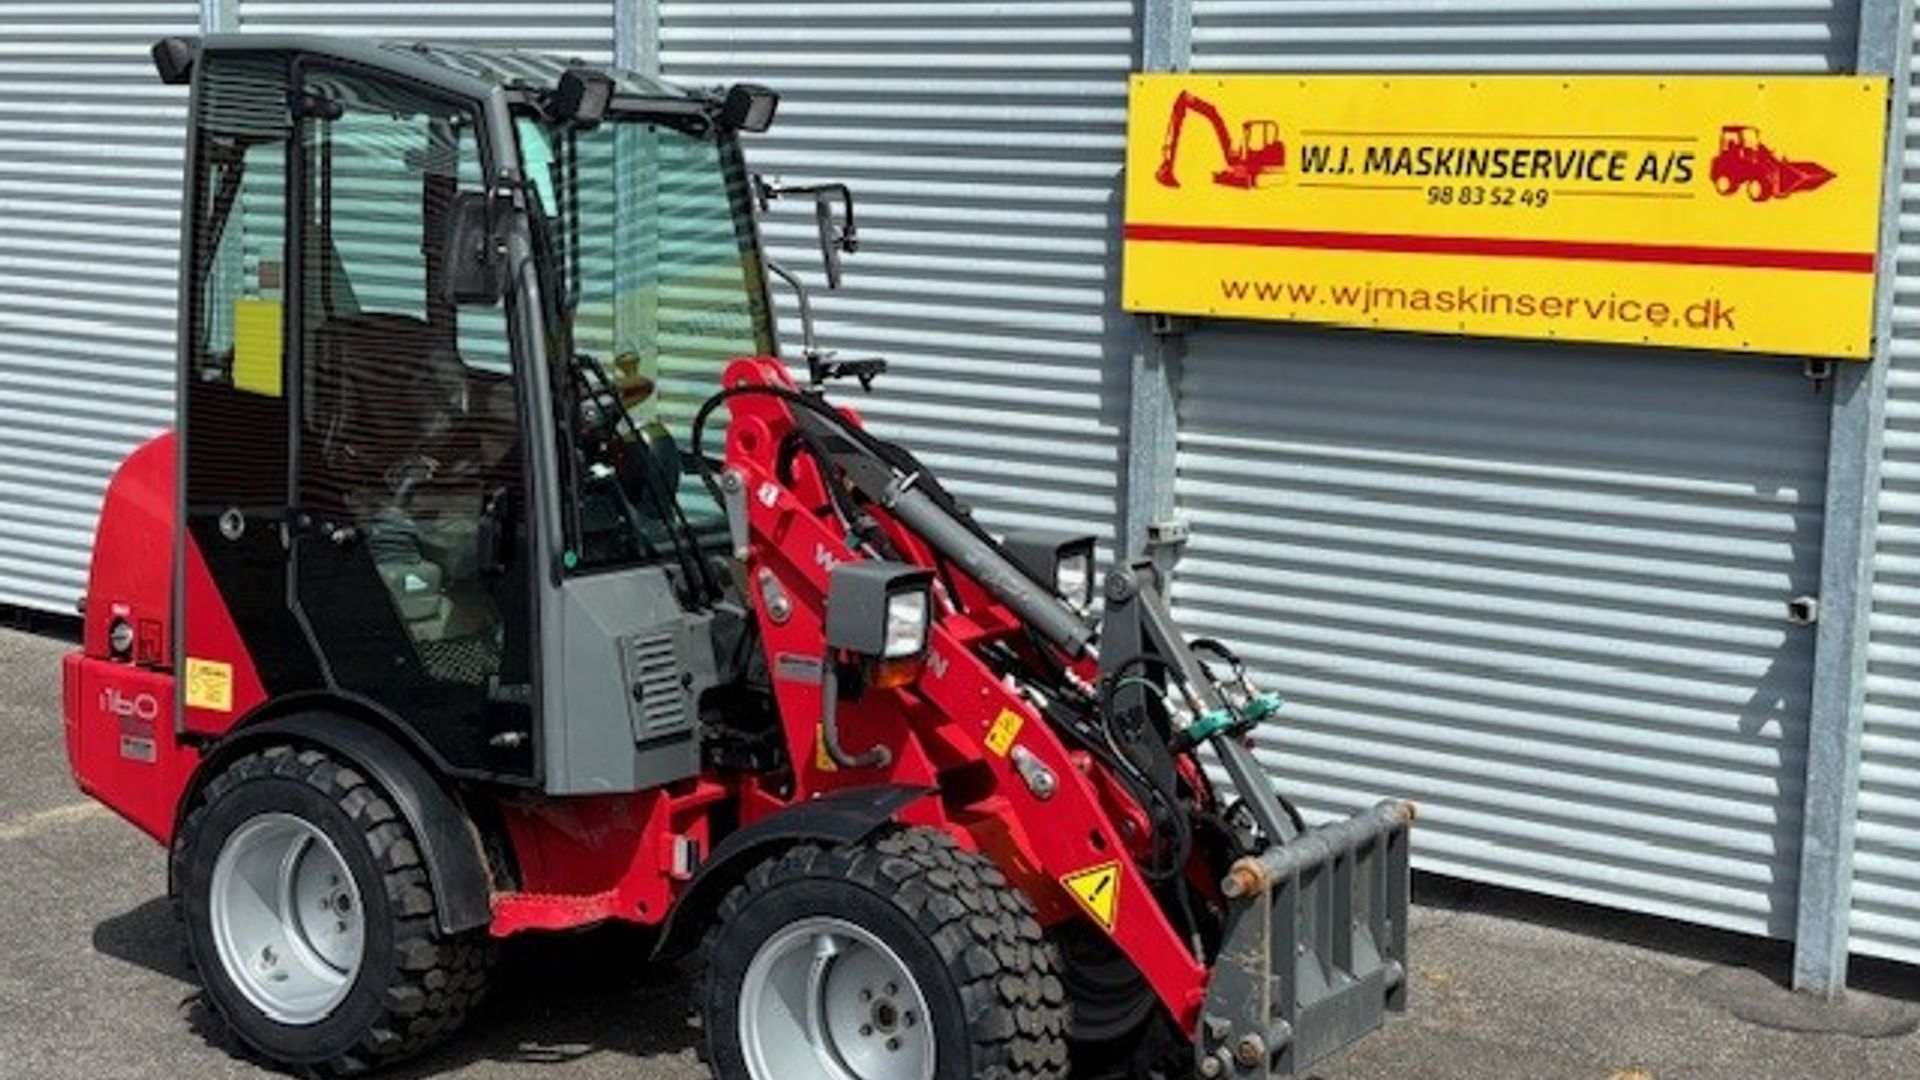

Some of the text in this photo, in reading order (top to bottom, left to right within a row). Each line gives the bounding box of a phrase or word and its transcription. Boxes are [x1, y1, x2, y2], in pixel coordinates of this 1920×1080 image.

[1362, 146, 1628, 182] MASKINSERVICE
[1634, 151, 1696, 184] A/S
[1427, 185, 1550, 208] 98 83 52 49
[1220, 278, 1737, 331] www.wjmaskinservice.dk
